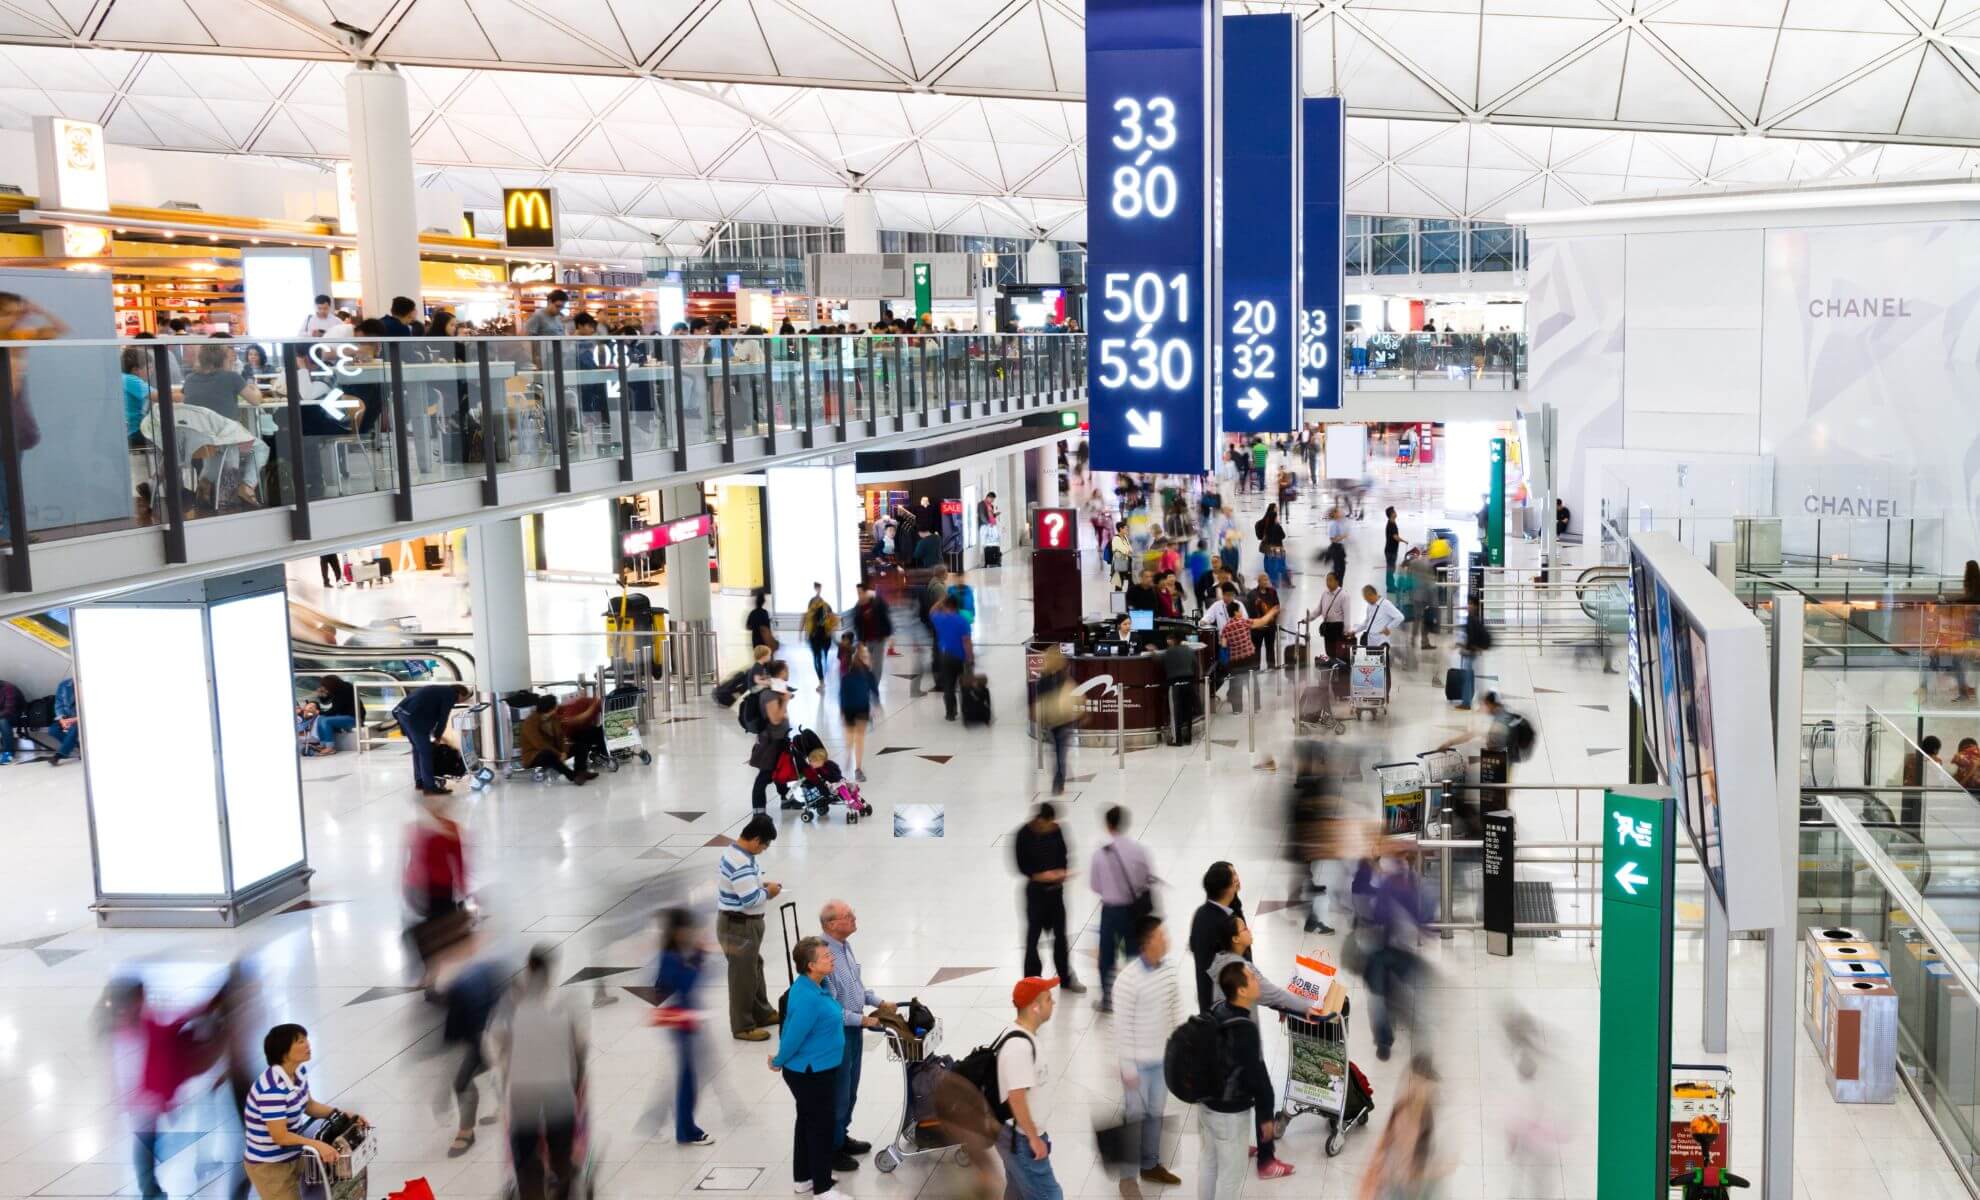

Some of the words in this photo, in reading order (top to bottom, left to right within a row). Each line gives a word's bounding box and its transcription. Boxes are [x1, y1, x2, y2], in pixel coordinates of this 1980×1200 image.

[1112, 97, 1177, 150] 33
[1111, 165, 1177, 218] 80
[1103, 272, 1188, 323] 501
[1809, 297, 1912, 319] CHANEL
[1232, 300, 1277, 335] 20
[1099, 338, 1193, 390] 530
[1232, 344, 1276, 379] 32
[943, 504, 961, 512] SALE
[1804, 494, 1902, 518] CHANEL
